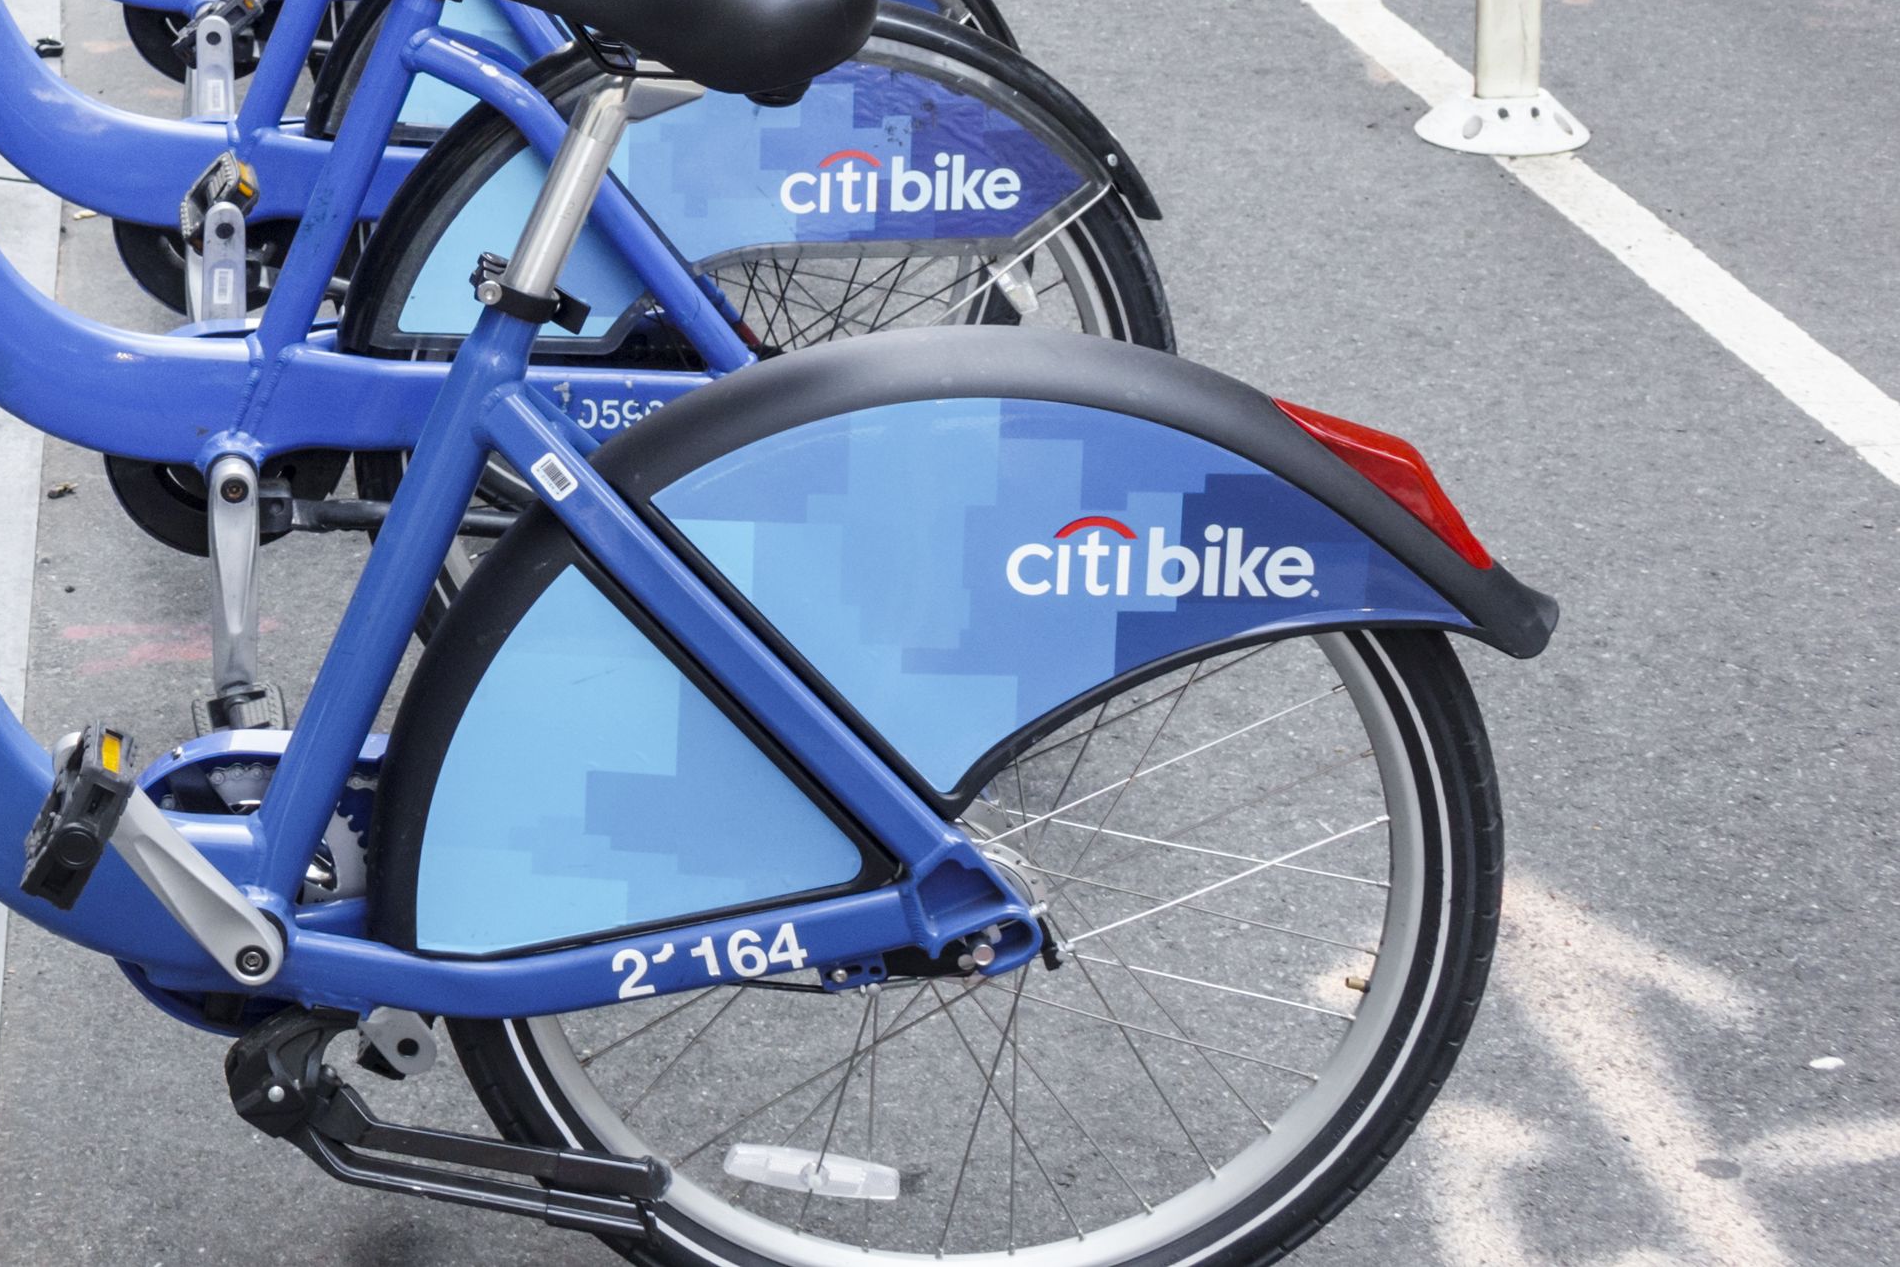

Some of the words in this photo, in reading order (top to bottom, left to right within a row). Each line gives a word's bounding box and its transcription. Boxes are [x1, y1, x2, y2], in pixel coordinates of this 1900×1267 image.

[780, 150, 882, 215] citi
[890, 152, 1022, 214] bike
[1005, 516, 1138, 597] citi
[1146, 523, 1316, 598] bike
